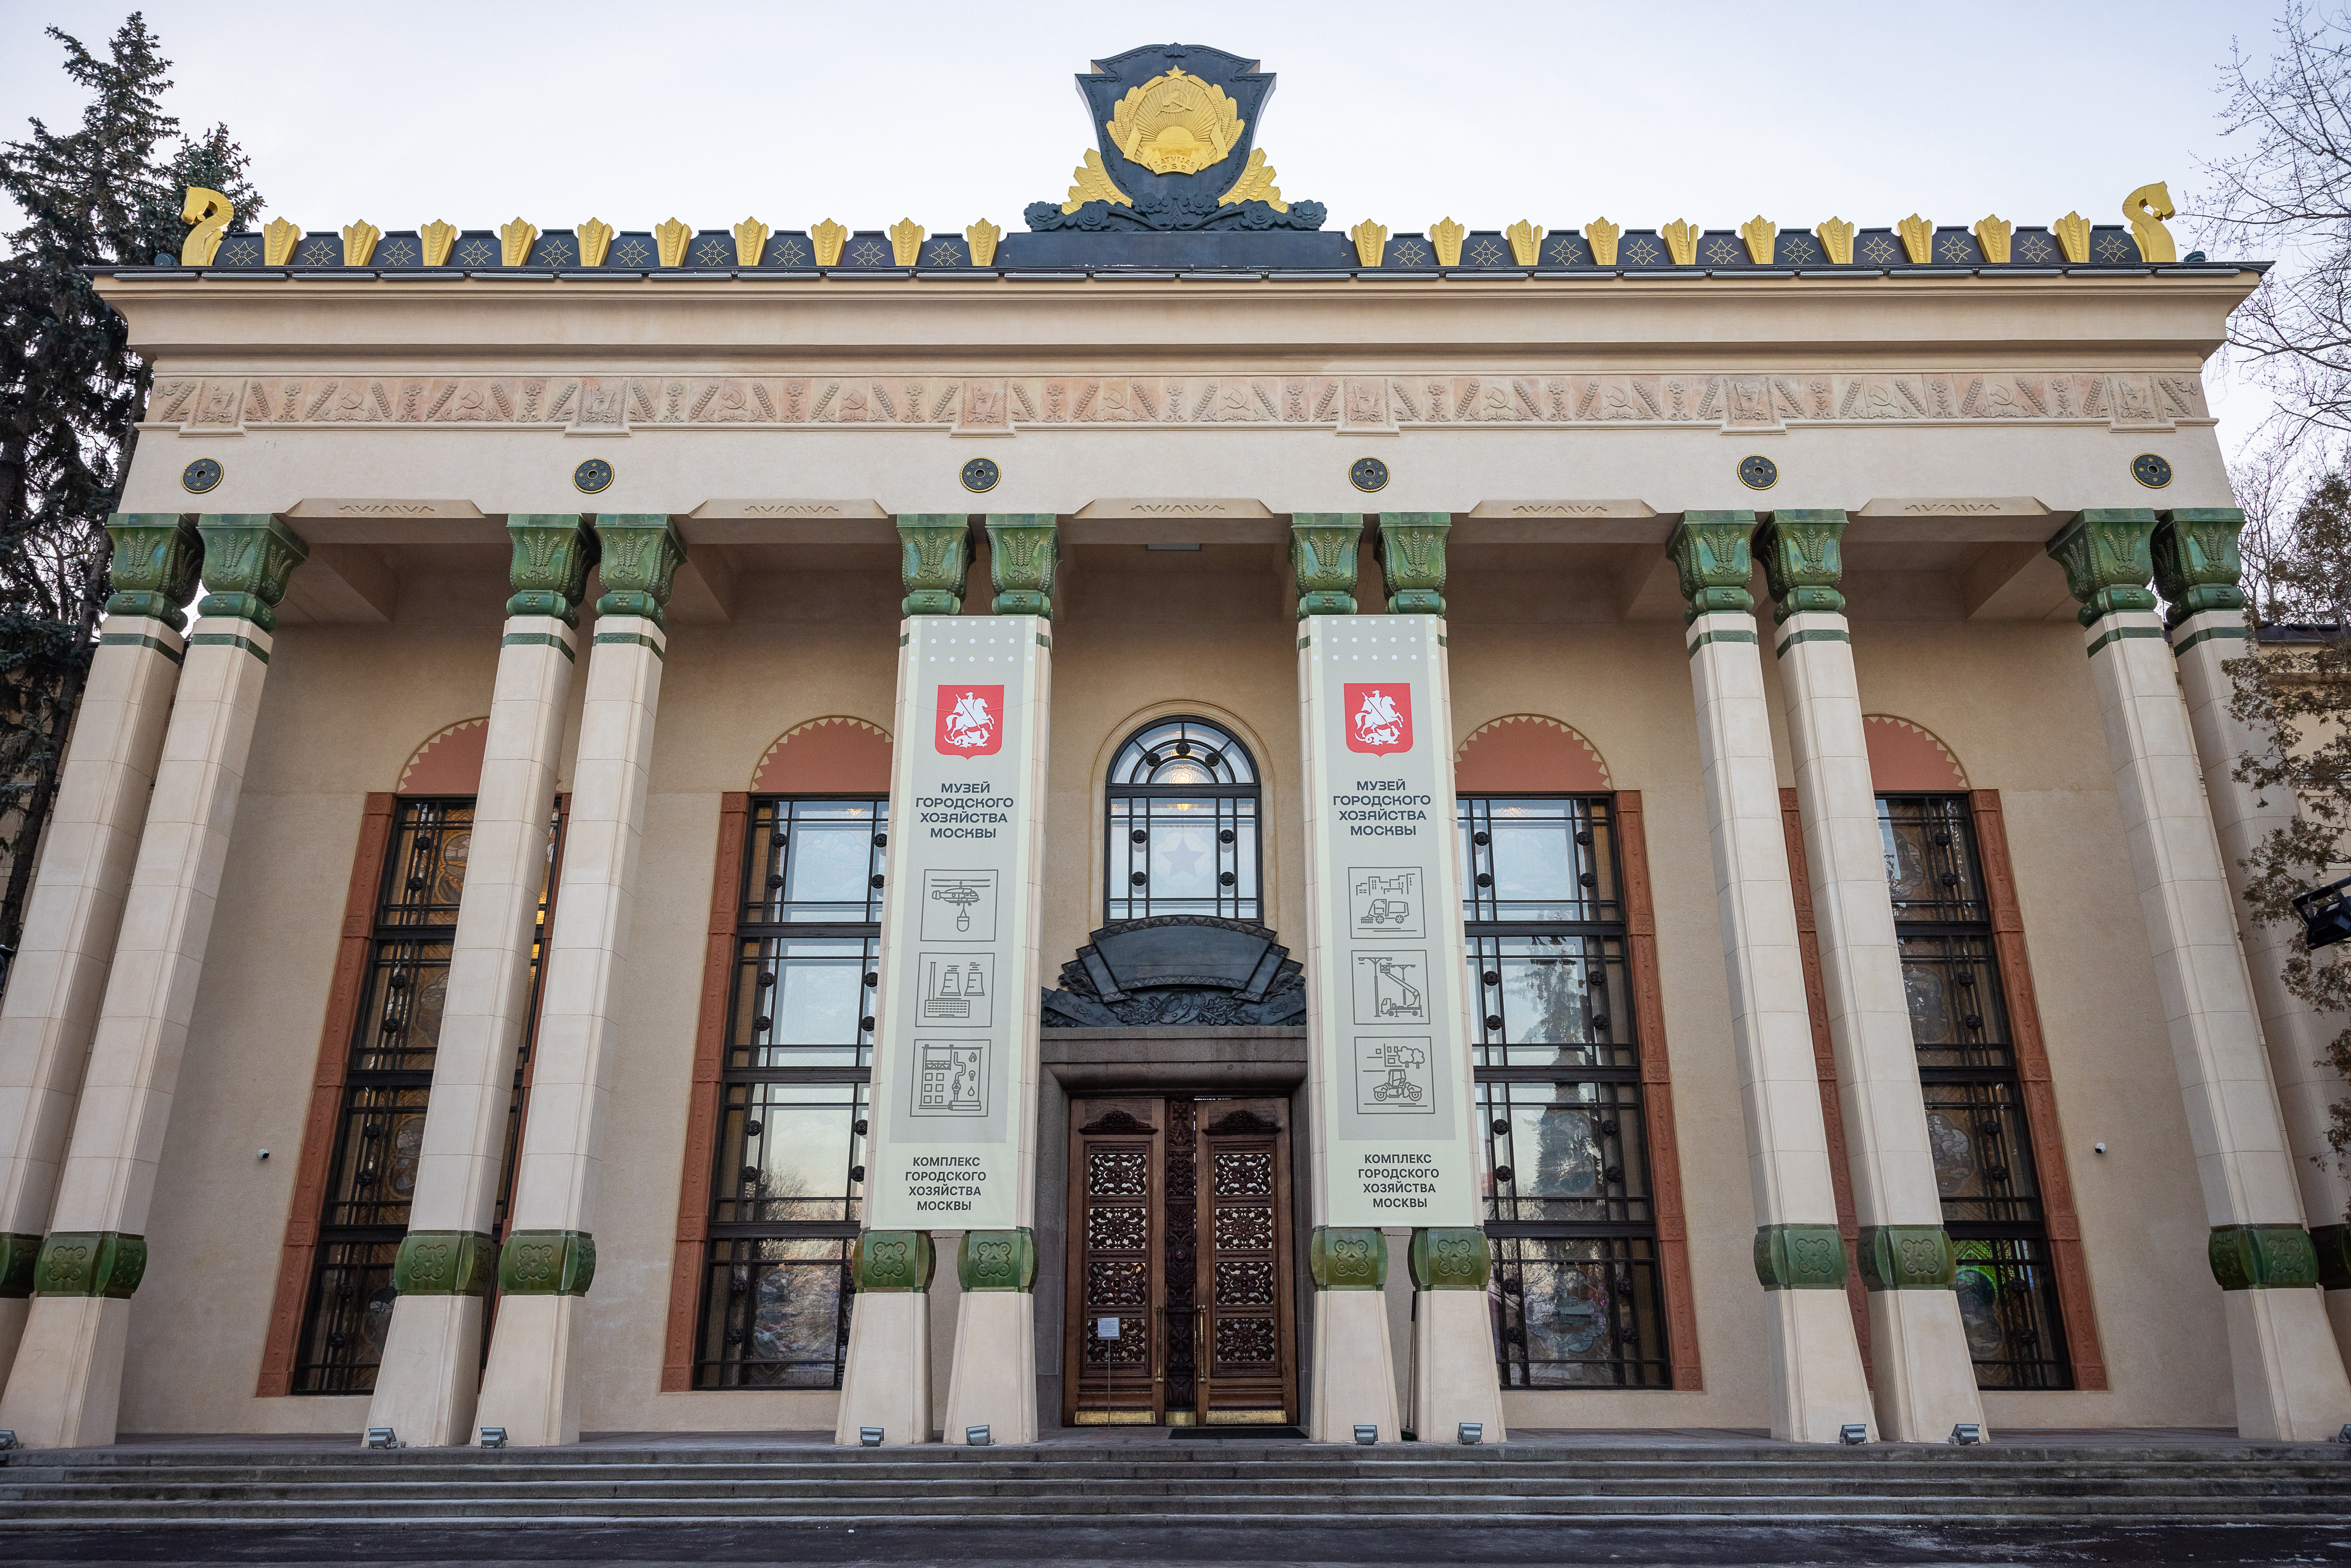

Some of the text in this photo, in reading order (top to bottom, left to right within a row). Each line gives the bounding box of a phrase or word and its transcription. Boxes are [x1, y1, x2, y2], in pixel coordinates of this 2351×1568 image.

[1154, 156, 1195, 167] LATVIJAS
[941, 781, 990, 793] МУЗЕЙ
[1357, 778, 1406, 791] МУЗЕЙ
[916, 797, 1014, 810] ГОРОДСКОГО
[1333, 795, 1431, 808] ГОРОДСКОГО
[920, 811, 1008, 823] ХОЗЯЙСТВА
[1339, 808, 1427, 821] ХОЗЯЙСТВА
[930, 828, 996, 838] МОСКВЫ
[1350, 825, 1416, 836] МОСКВЫ
[913, 1156, 980, 1166] КОМПЛЕКС
[1365, 1154, 1432, 1164] КОМПЛЕКС
[905, 1171, 986, 1183] ГОРОДСКОГО
[1358, 1168, 1439, 1180] ГОРОДСКОГО
[908, 1183, 981, 1196] ХОЗЯЙСТВА
[1363, 1180, 1436, 1193] ХОЗЯЙСТВА
[917, 1201, 971, 1211] МОСКВЫ
[1373, 1198, 1427, 1208] МОСКВЫ
